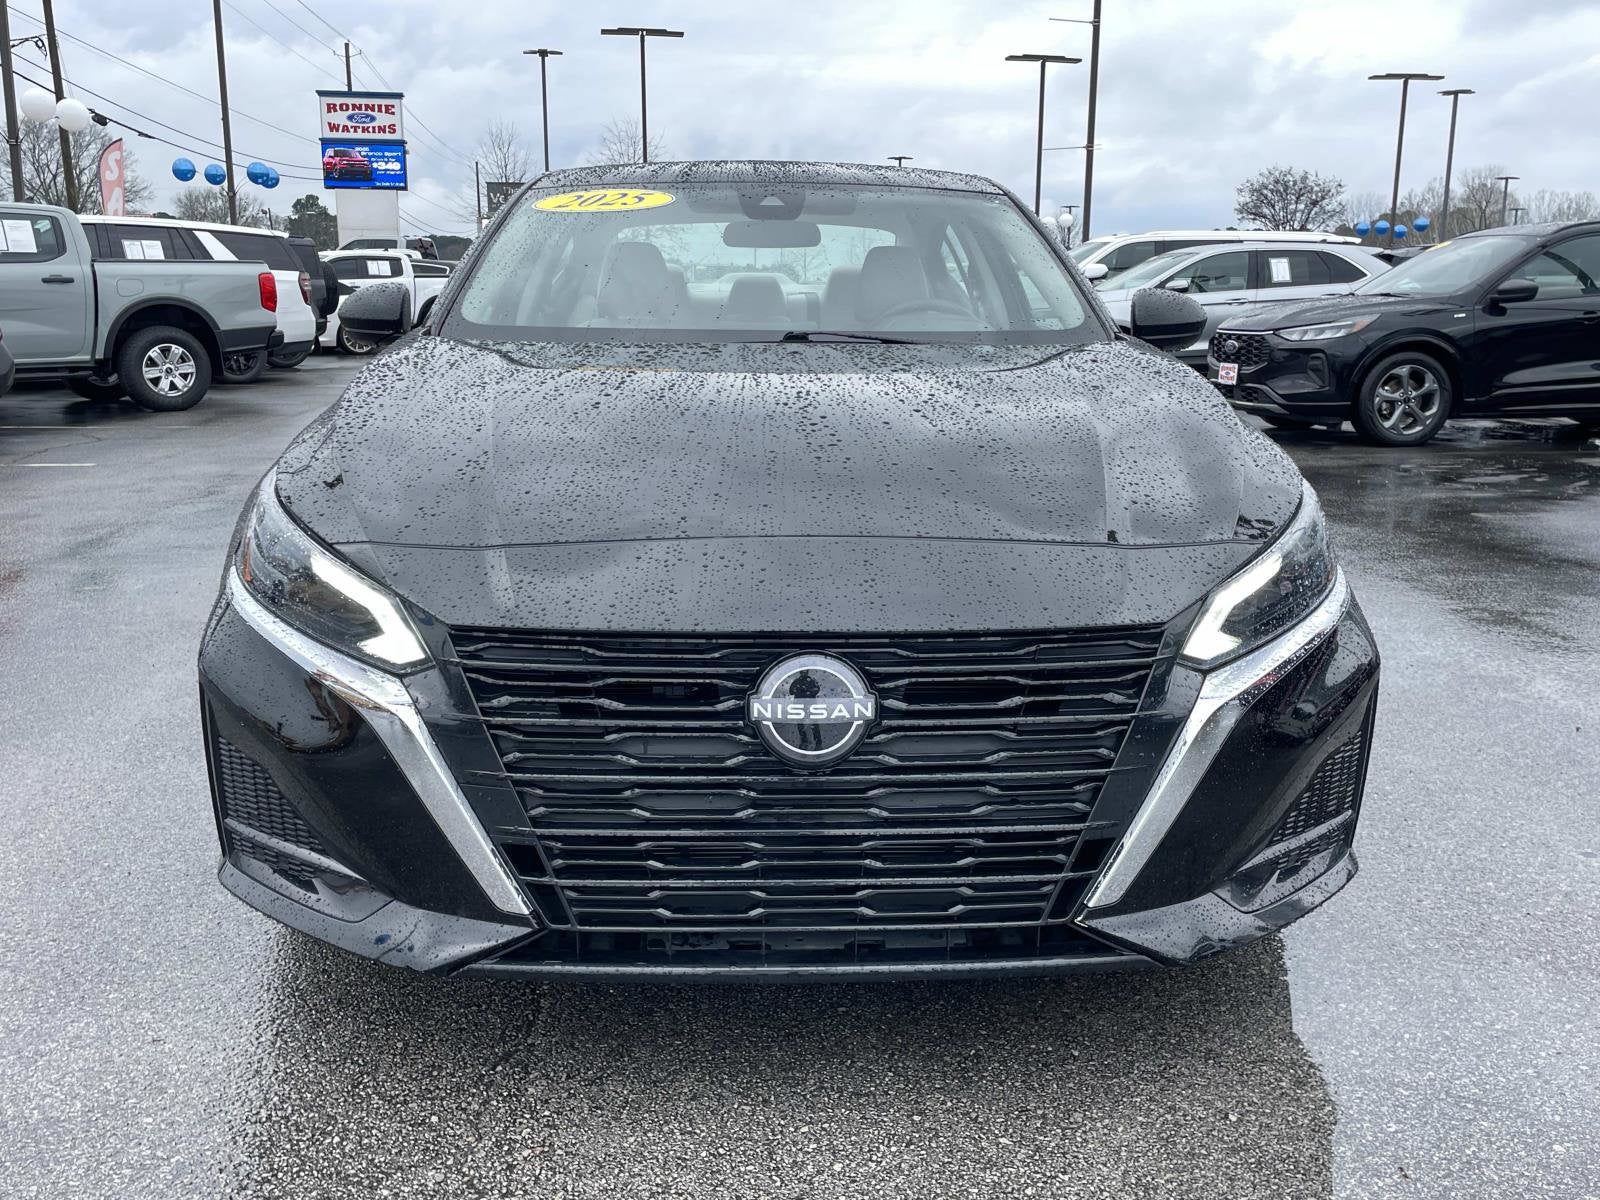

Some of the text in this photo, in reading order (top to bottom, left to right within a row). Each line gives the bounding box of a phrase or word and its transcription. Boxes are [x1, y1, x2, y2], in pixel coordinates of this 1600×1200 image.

[326, 102, 396, 115] RONNIE
[352, 114, 371, 123] Ford
[327, 121, 397, 135] WATKINS
[553, 193, 654, 208] 2025
[753, 702, 872, 719] NISSAN
